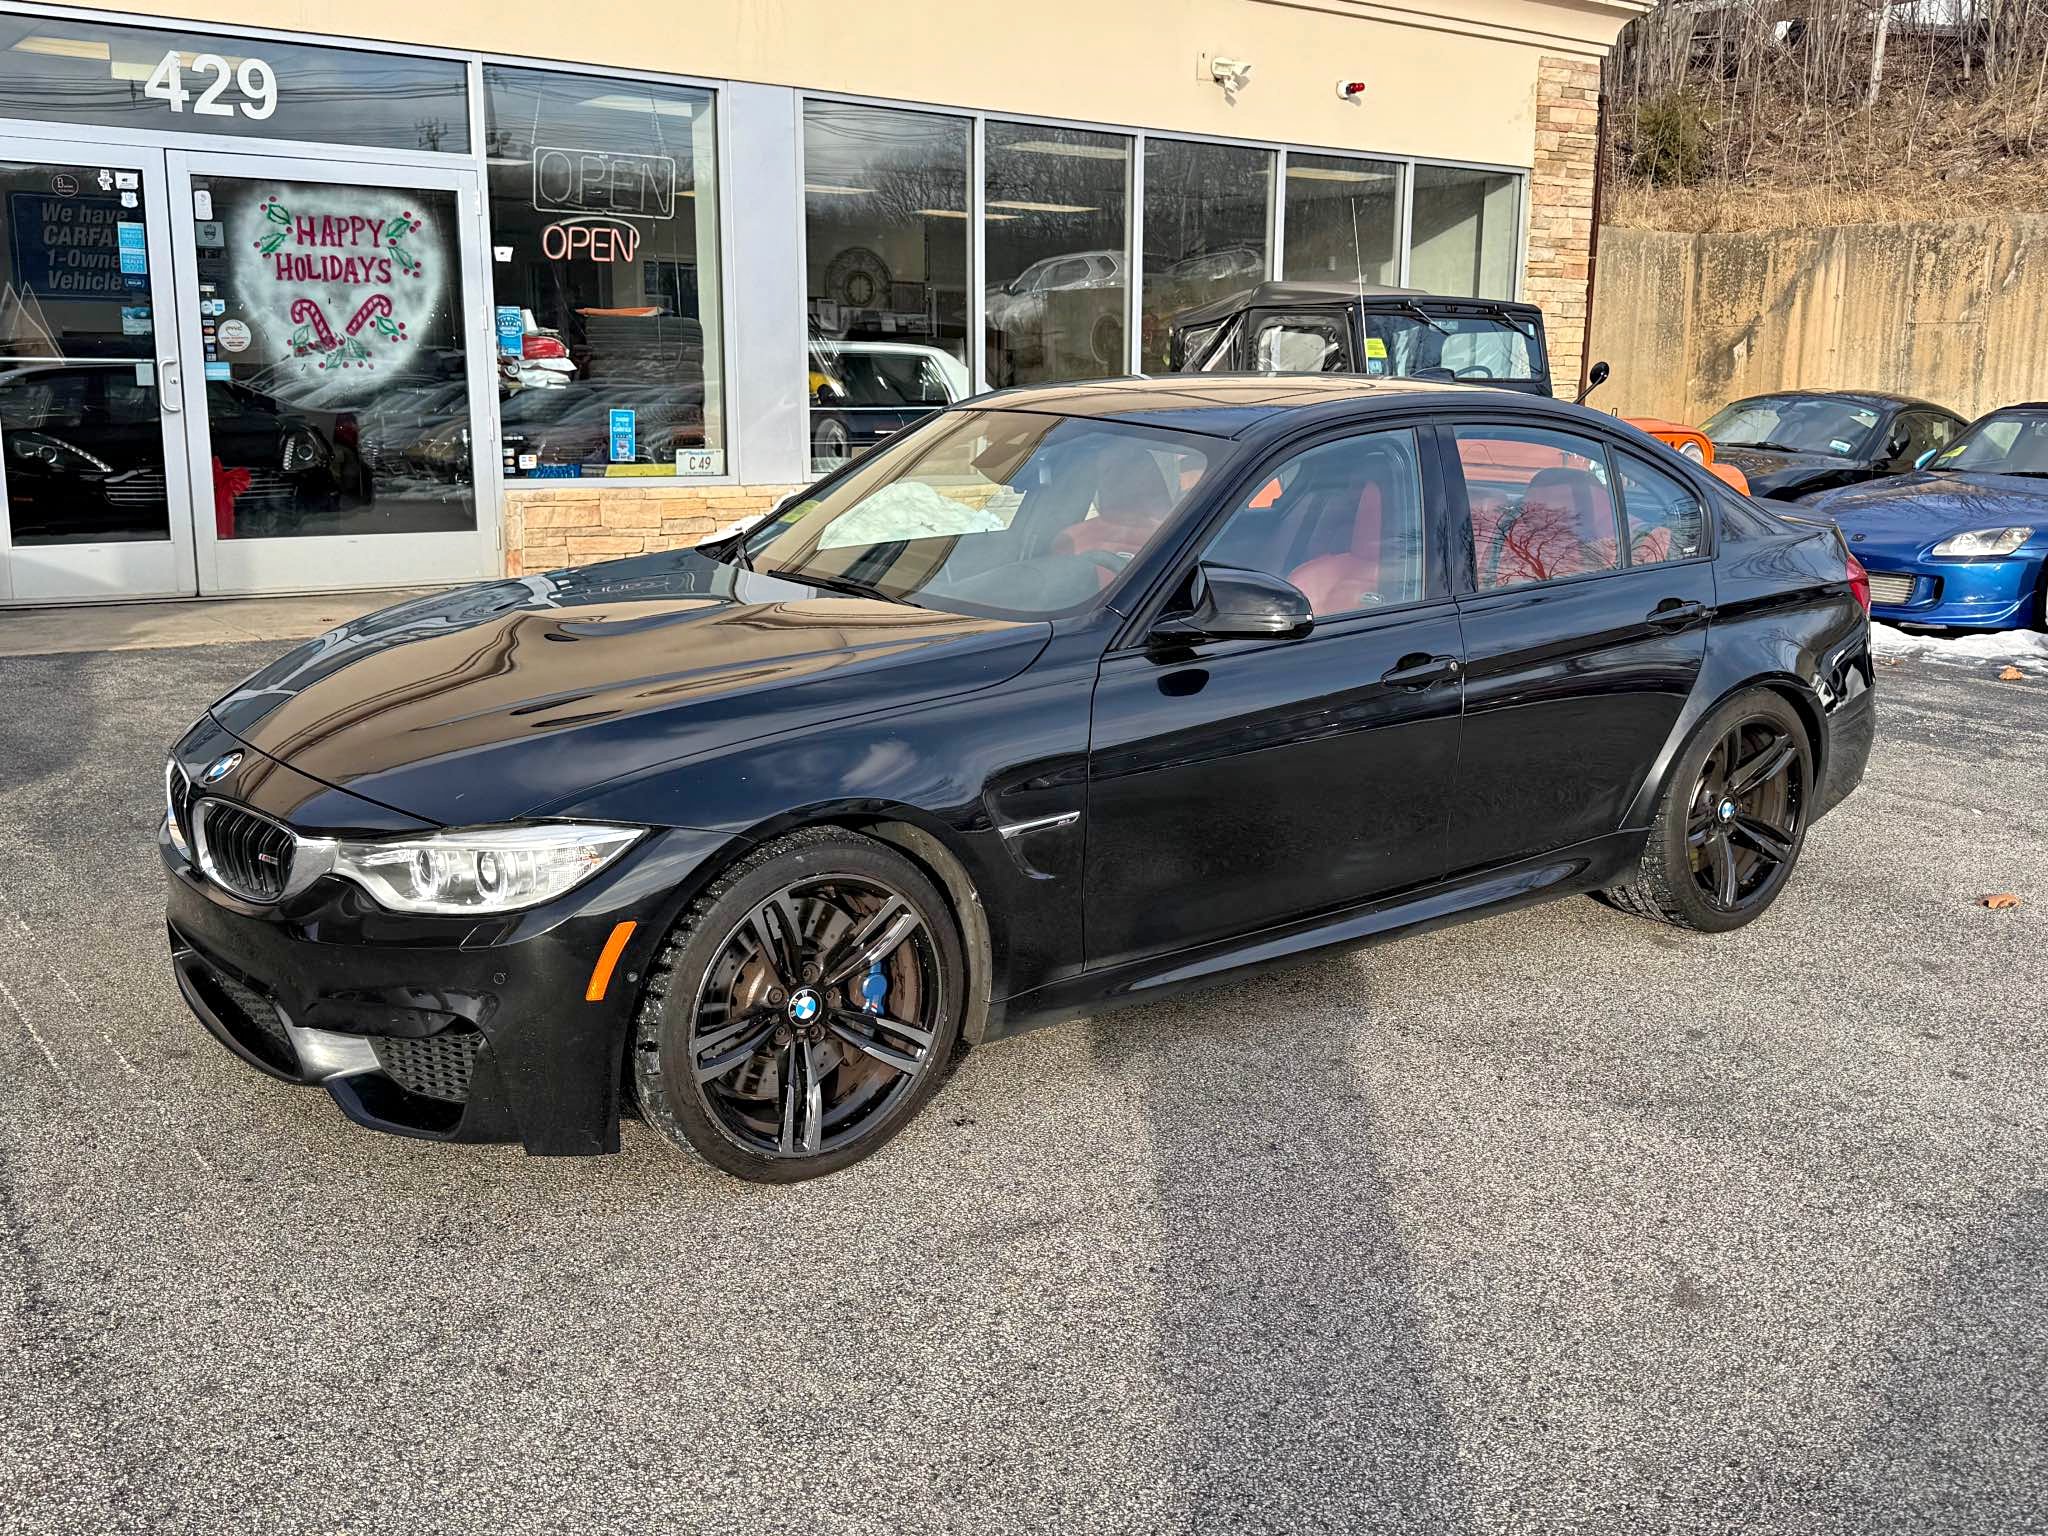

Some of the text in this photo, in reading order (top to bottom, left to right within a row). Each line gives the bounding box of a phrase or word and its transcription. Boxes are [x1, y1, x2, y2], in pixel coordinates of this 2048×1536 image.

[144, 50, 278, 120] 429
[540, 151, 670, 213] OPEN
[42, 202, 128, 225] We have
[43, 225, 119, 247] CARFA
[295, 214, 386, 248] HAPPY
[542, 225, 635, 262] OPEN
[48, 249, 120, 269] 1-Owne
[275, 252, 392, 284] HOLIDAYS
[48, 270, 124, 291] Vehicle
[689, 456, 711, 470] C 49
